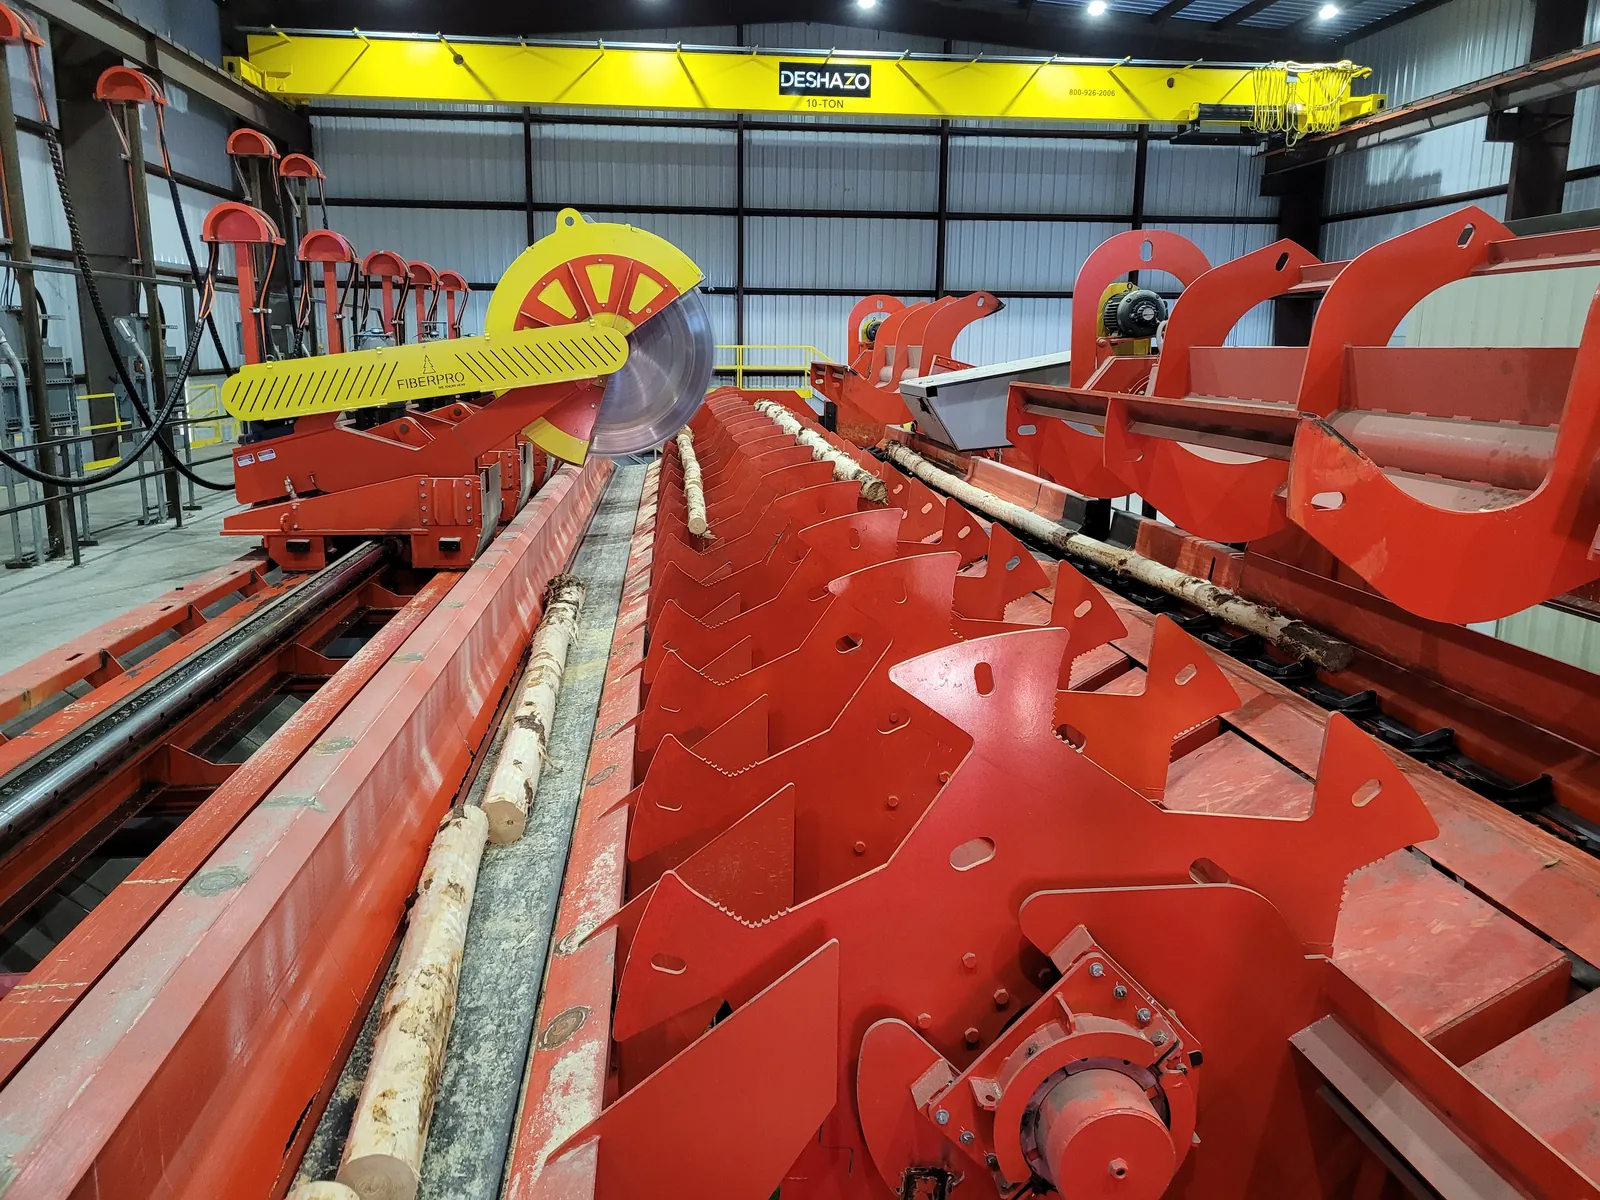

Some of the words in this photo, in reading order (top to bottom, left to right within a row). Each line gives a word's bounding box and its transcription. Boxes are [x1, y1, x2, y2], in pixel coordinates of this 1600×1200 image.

[780, 71, 870, 90] DESHAZO
[1069, 88, 1116, 97] 800-926-2006
[806, 98, 844, 109] 10-TON
[397, 371, 465, 390] FIBERPRO
